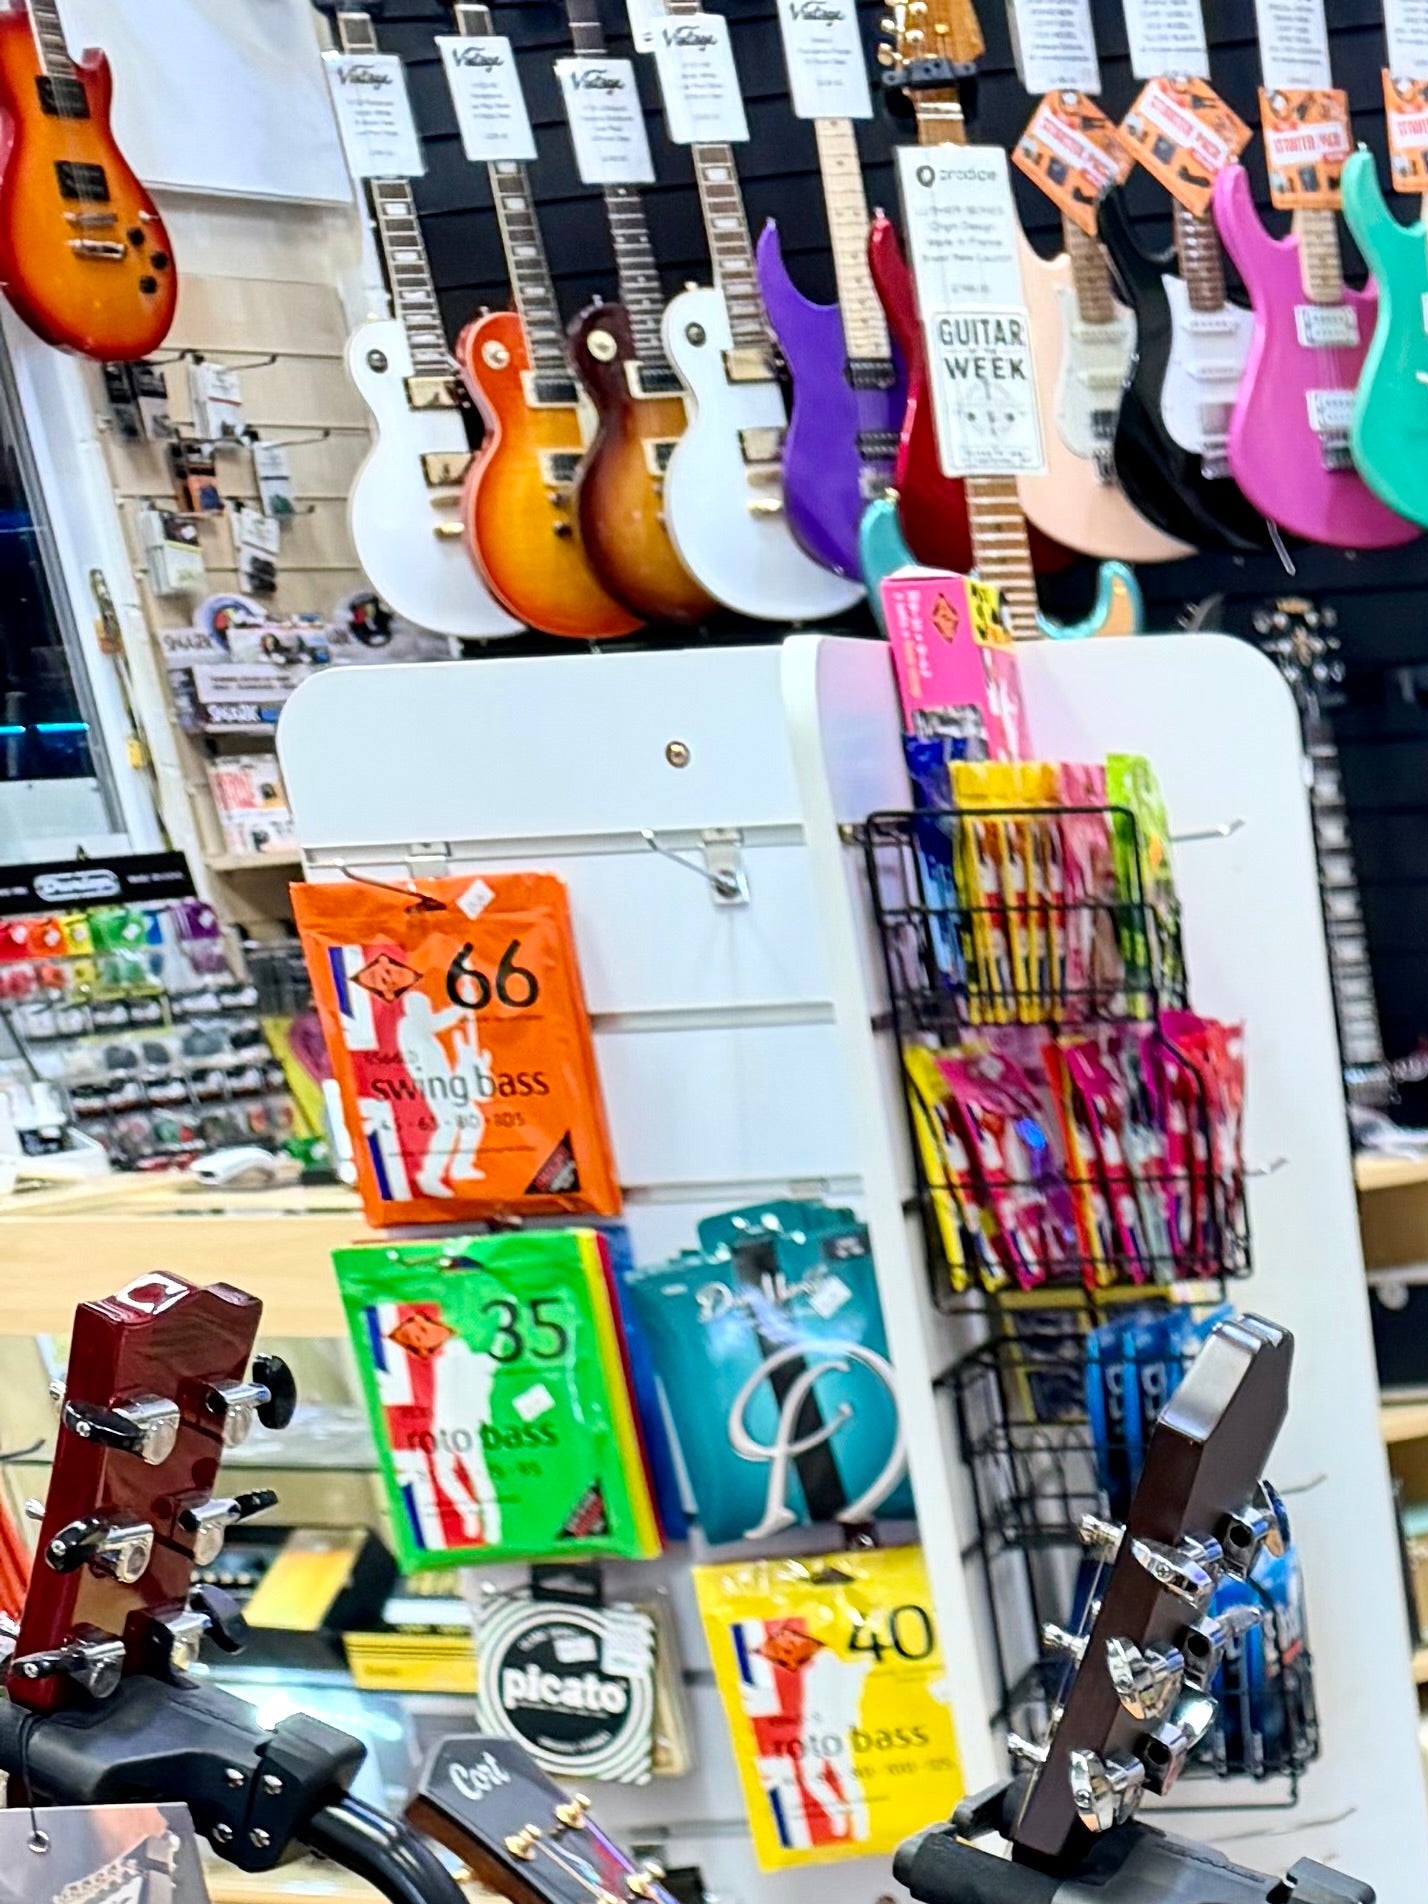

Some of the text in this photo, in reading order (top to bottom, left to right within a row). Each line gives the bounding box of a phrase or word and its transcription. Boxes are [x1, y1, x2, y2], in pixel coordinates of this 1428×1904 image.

[939, 318, 1025, 347] GUITAR
[943, 355, 1027, 380] WEEK
[446, 938, 540, 1010] 66
[371, 1065, 549, 1108] swing bass
[481, 1296, 568, 1363] 35
[479, 1420, 560, 1450] bass
[848, 1604, 935, 1663] 40
[502, 1663, 628, 1715] picato
[850, 1724, 930, 1753] bass
[449, 1750, 512, 1801] Cort
